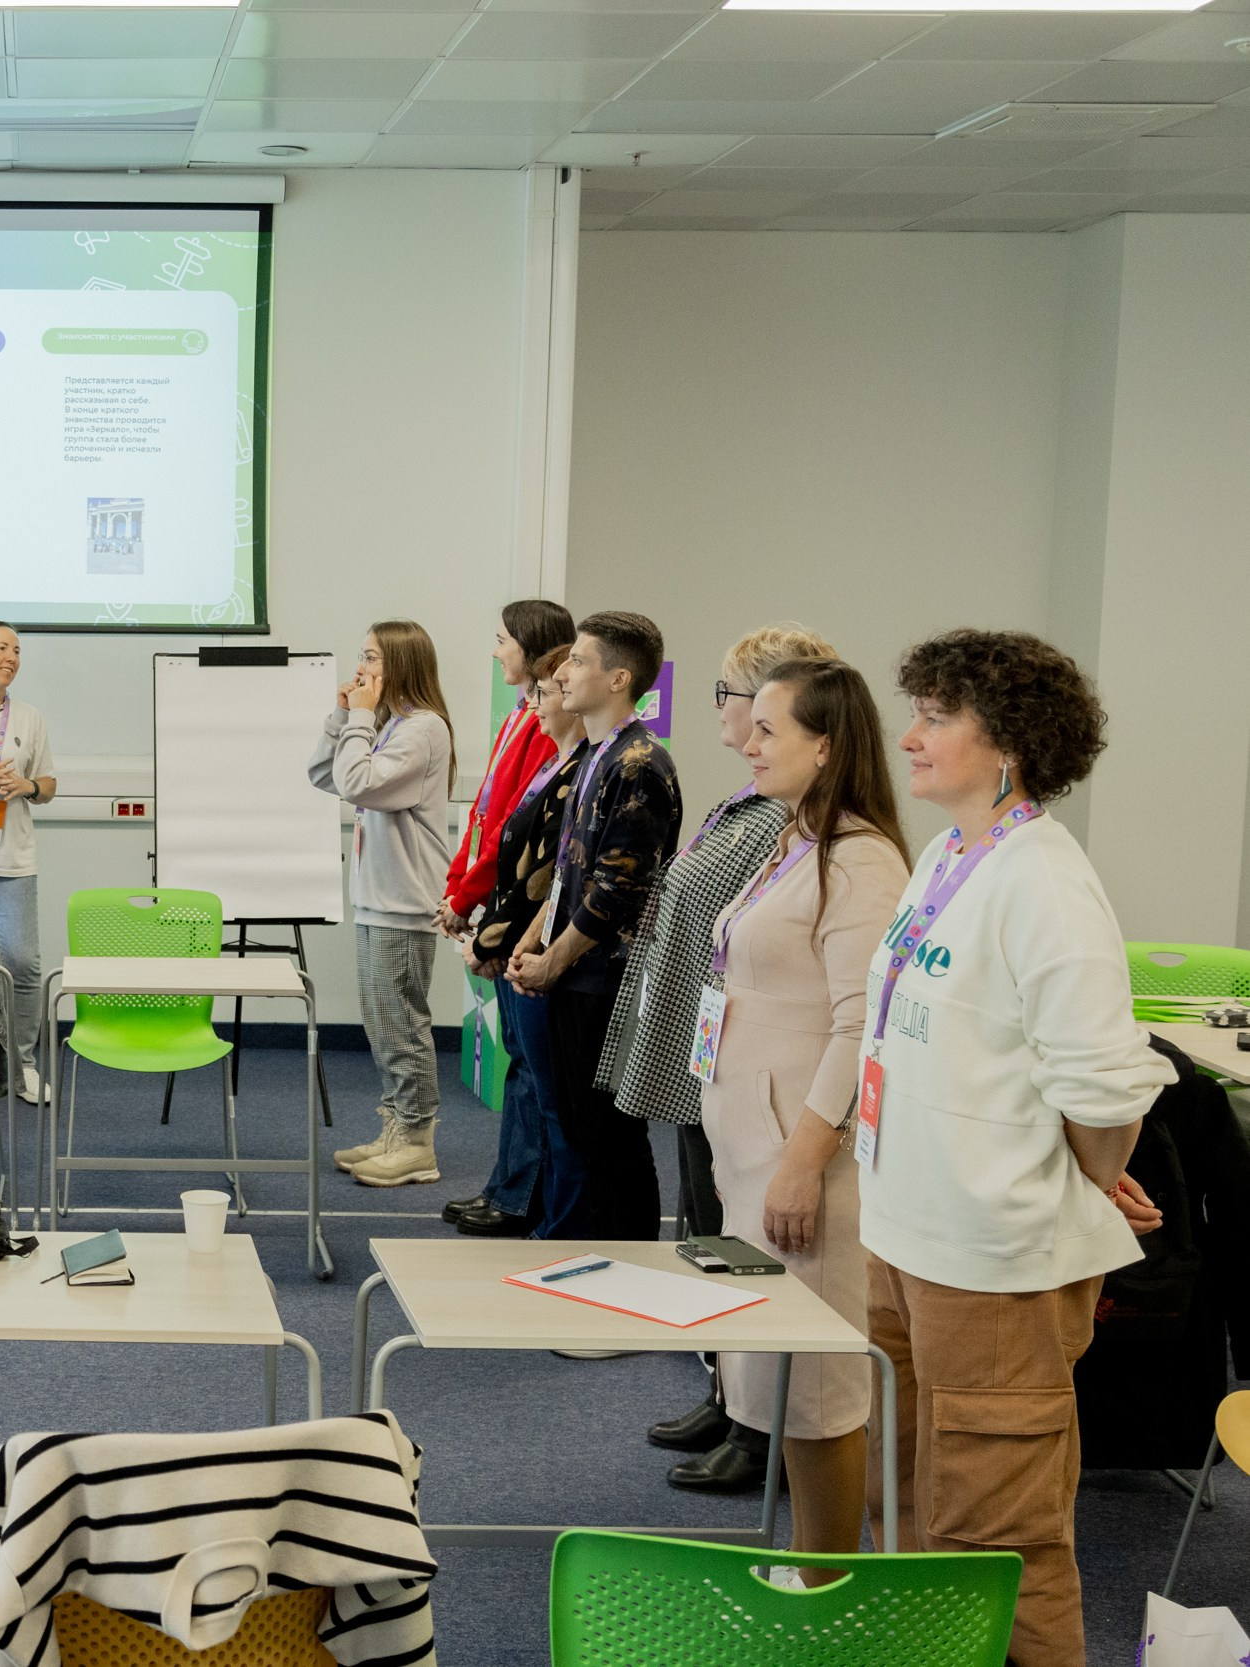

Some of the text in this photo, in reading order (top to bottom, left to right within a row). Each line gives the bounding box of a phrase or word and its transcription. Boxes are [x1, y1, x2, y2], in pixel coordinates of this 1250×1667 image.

[57, 332, 109, 340] Знакомство
[117, 334, 176, 342] участниками
[65, 376, 170, 385] Представляется каждый
[64, 387, 136, 395] участник, кратко
[128, 396, 150, 404] себе.
[101, 407, 139, 415] краткого
[115, 417, 166, 425] проводится
[64, 426, 84, 434] игра
[134, 426, 159, 434] чтобы
[64, 436, 94, 444] группа
[121, 435, 147, 443] более
[64, 454, 102, 463] барьеры.
